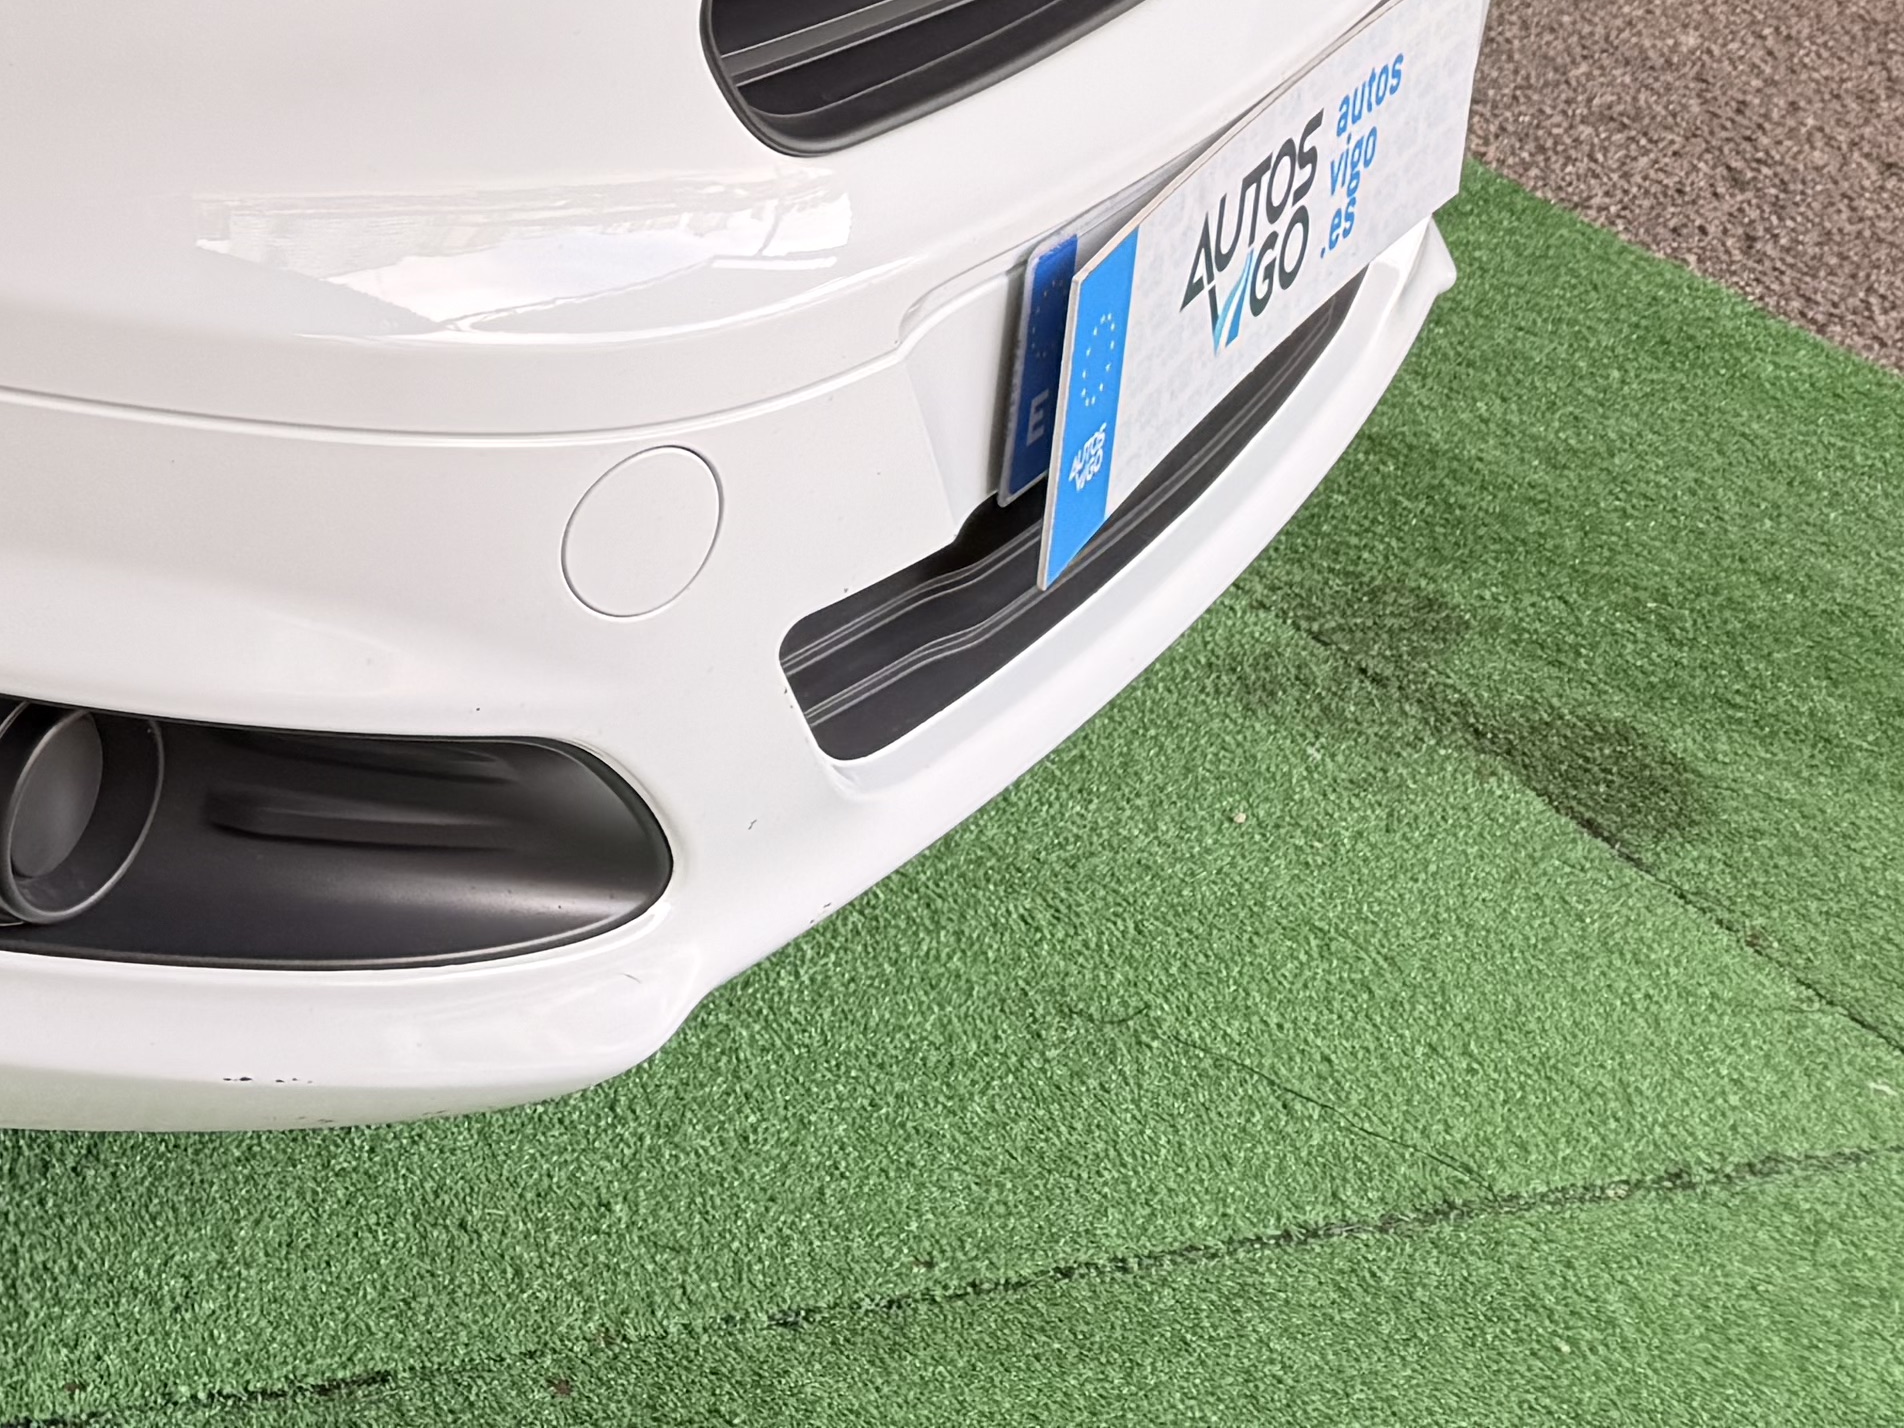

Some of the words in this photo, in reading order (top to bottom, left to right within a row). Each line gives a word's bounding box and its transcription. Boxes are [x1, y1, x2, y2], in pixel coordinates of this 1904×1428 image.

[1335, 53, 1404, 138] autos
[1328, 126, 1378, 197] vigo
[1179, 107, 1324, 313] AUTOS
[1318, 195, 1356, 259] .es
[1026, 387, 1050, 447] E
[1068, 422, 1107, 482] AUTOS
